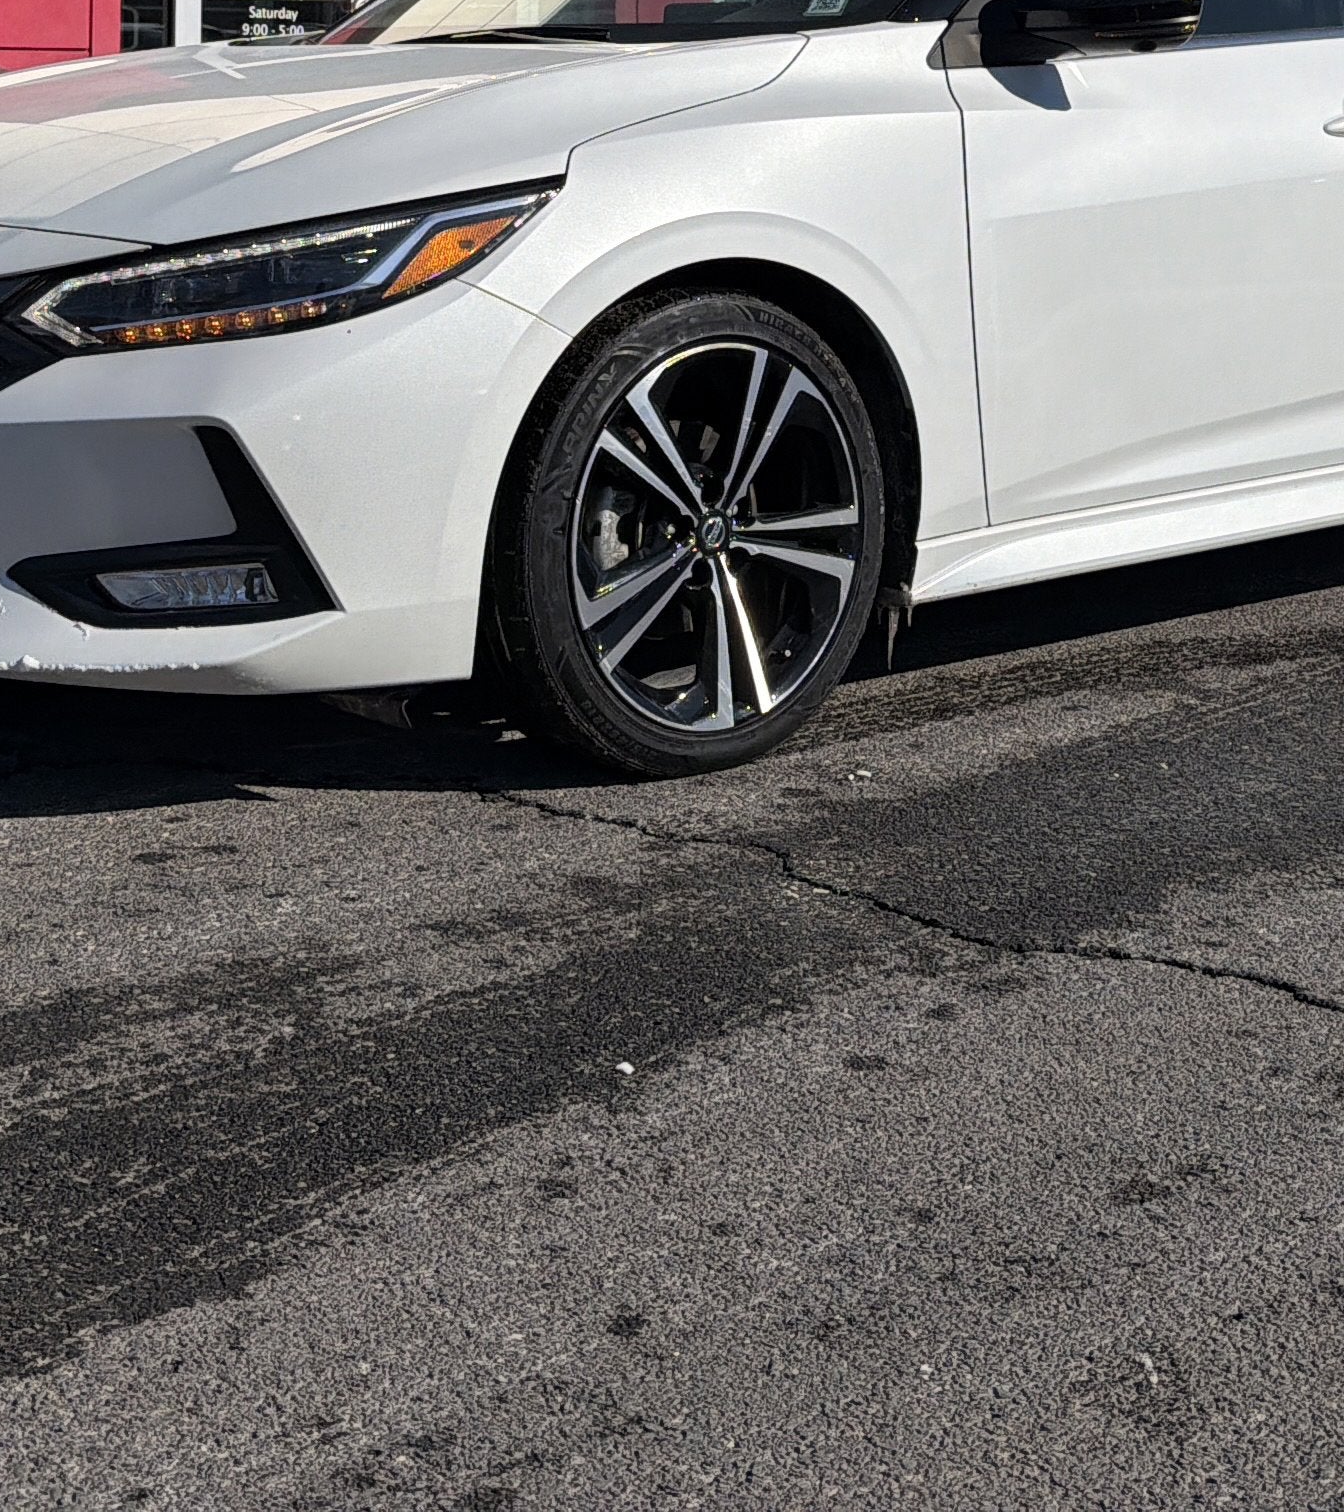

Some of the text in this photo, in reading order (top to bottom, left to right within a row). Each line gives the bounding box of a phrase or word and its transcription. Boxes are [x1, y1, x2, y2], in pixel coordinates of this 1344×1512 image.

[248, 5, 299, 22] Saturday
[242, 23, 269, 36] 9:00
[278, 24, 305, 36] 5:00
